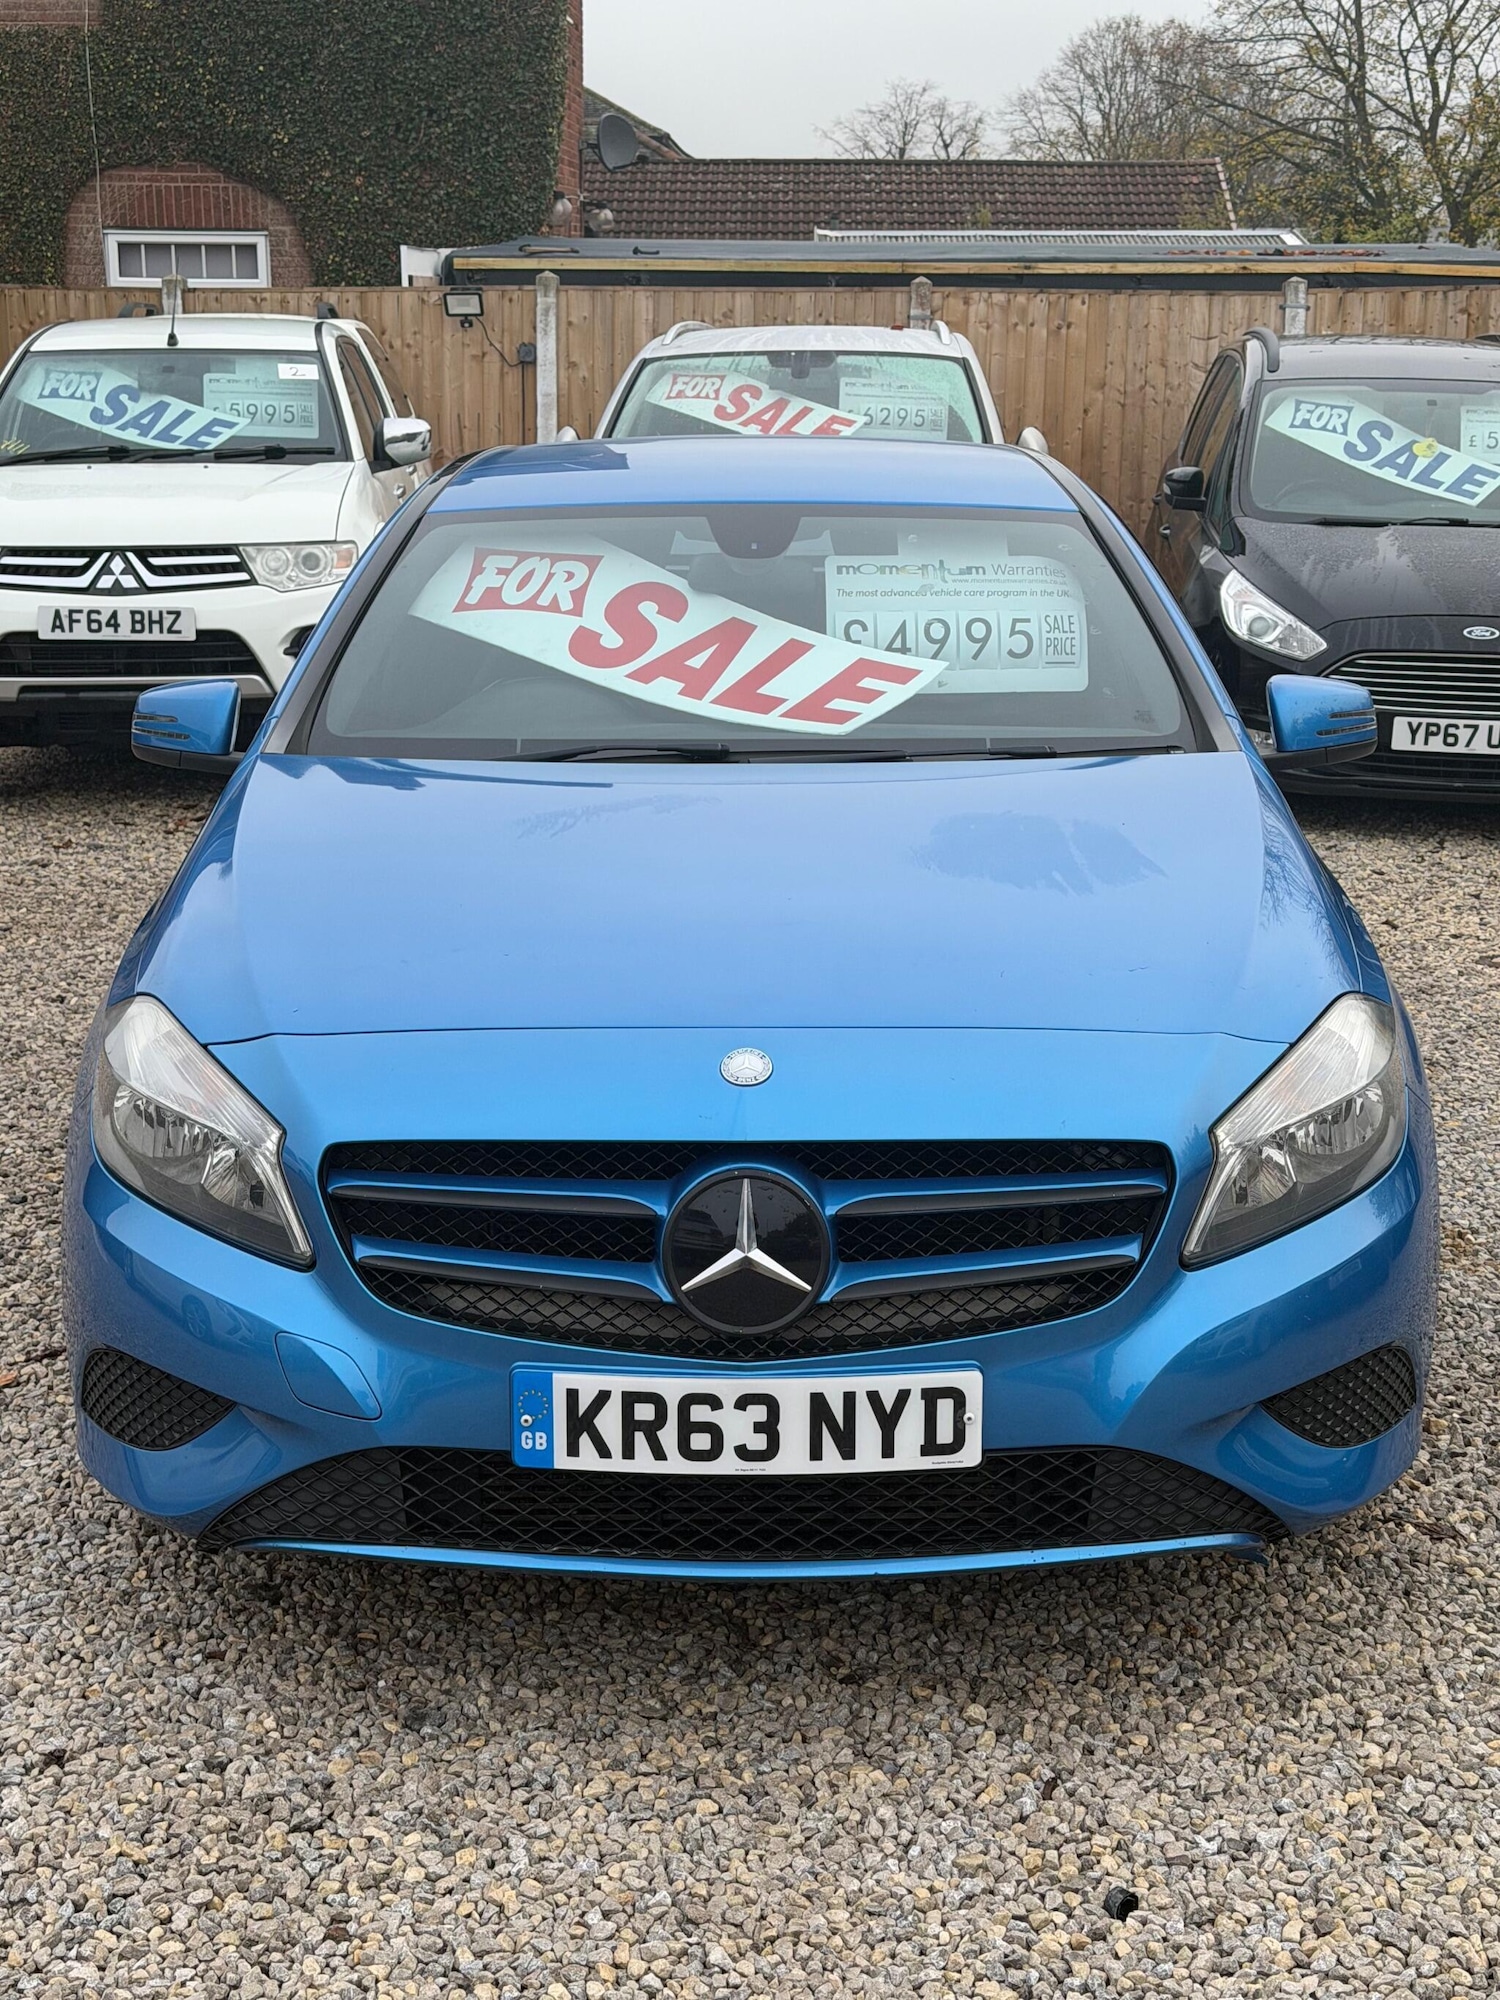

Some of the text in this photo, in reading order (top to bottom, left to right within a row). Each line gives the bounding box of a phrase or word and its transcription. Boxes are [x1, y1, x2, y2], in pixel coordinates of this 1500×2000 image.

[42, 371, 240, 449] FOR SALE
[669, 376, 857, 435] FOR SALE
[1293, 403, 1500, 500] FOR SALE
[836, 559, 1067, 584] momentum Warranties
[836, 588, 854, 598] The
[855, 589, 878, 598] most
[930, 588, 962, 598] vehicle
[964, 589, 985, 598] care
[987, 590, 1028, 601] program
[1030, 589, 1038, 598] in
[1040, 589, 1055, 598] the
[50, 609, 182, 634] AF64 BHZ
[1044, 615, 1076, 634] SALE
[472, 554, 922, 726] FOR SALE
[1045, 637, 1076, 656] PRICE
[1407, 721, 1480, 748] YP67
[566, 1386, 967, 1462] KR63 NYD
[521, 1431, 547, 1450] GB
